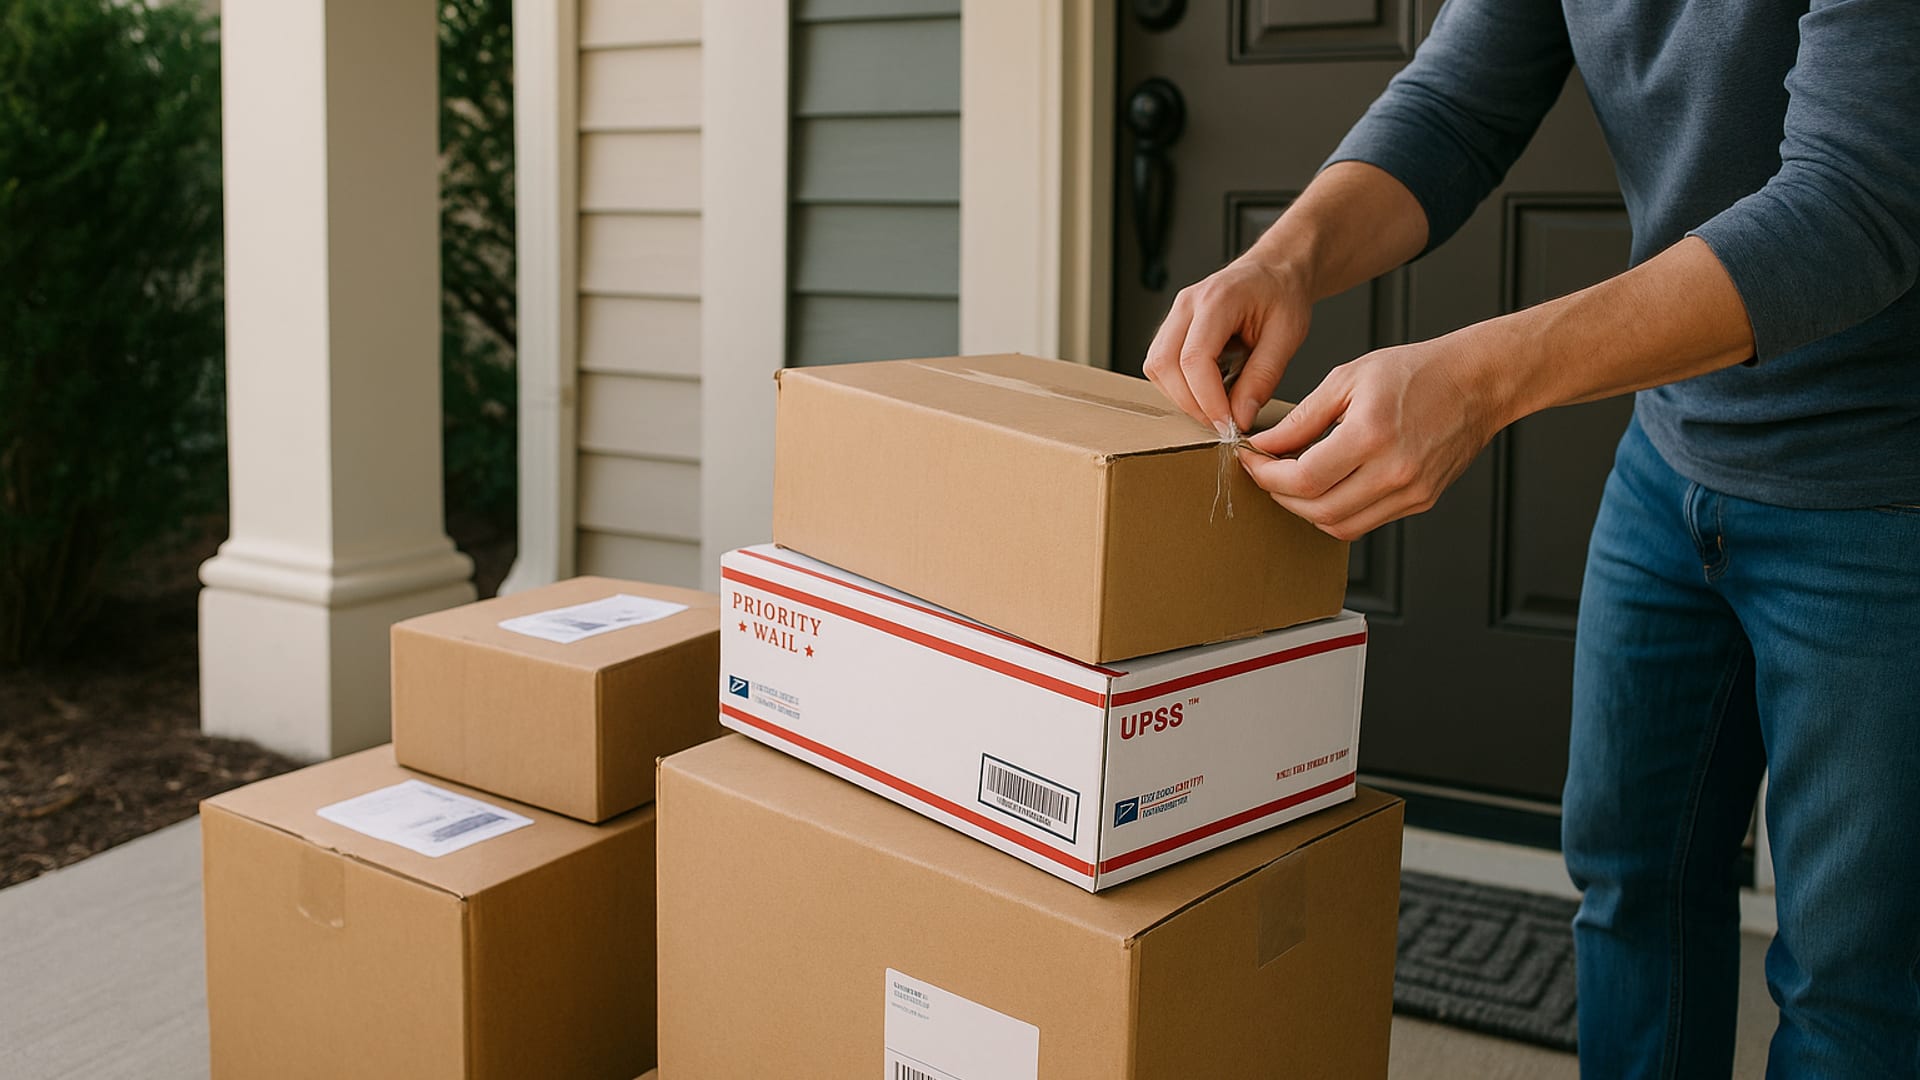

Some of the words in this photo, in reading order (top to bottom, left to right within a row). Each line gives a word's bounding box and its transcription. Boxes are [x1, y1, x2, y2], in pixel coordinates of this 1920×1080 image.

[732, 591, 822, 636] PRIORITY
[753, 621, 798, 653] WAIL
[1121, 702, 1184, 740] UPSS
